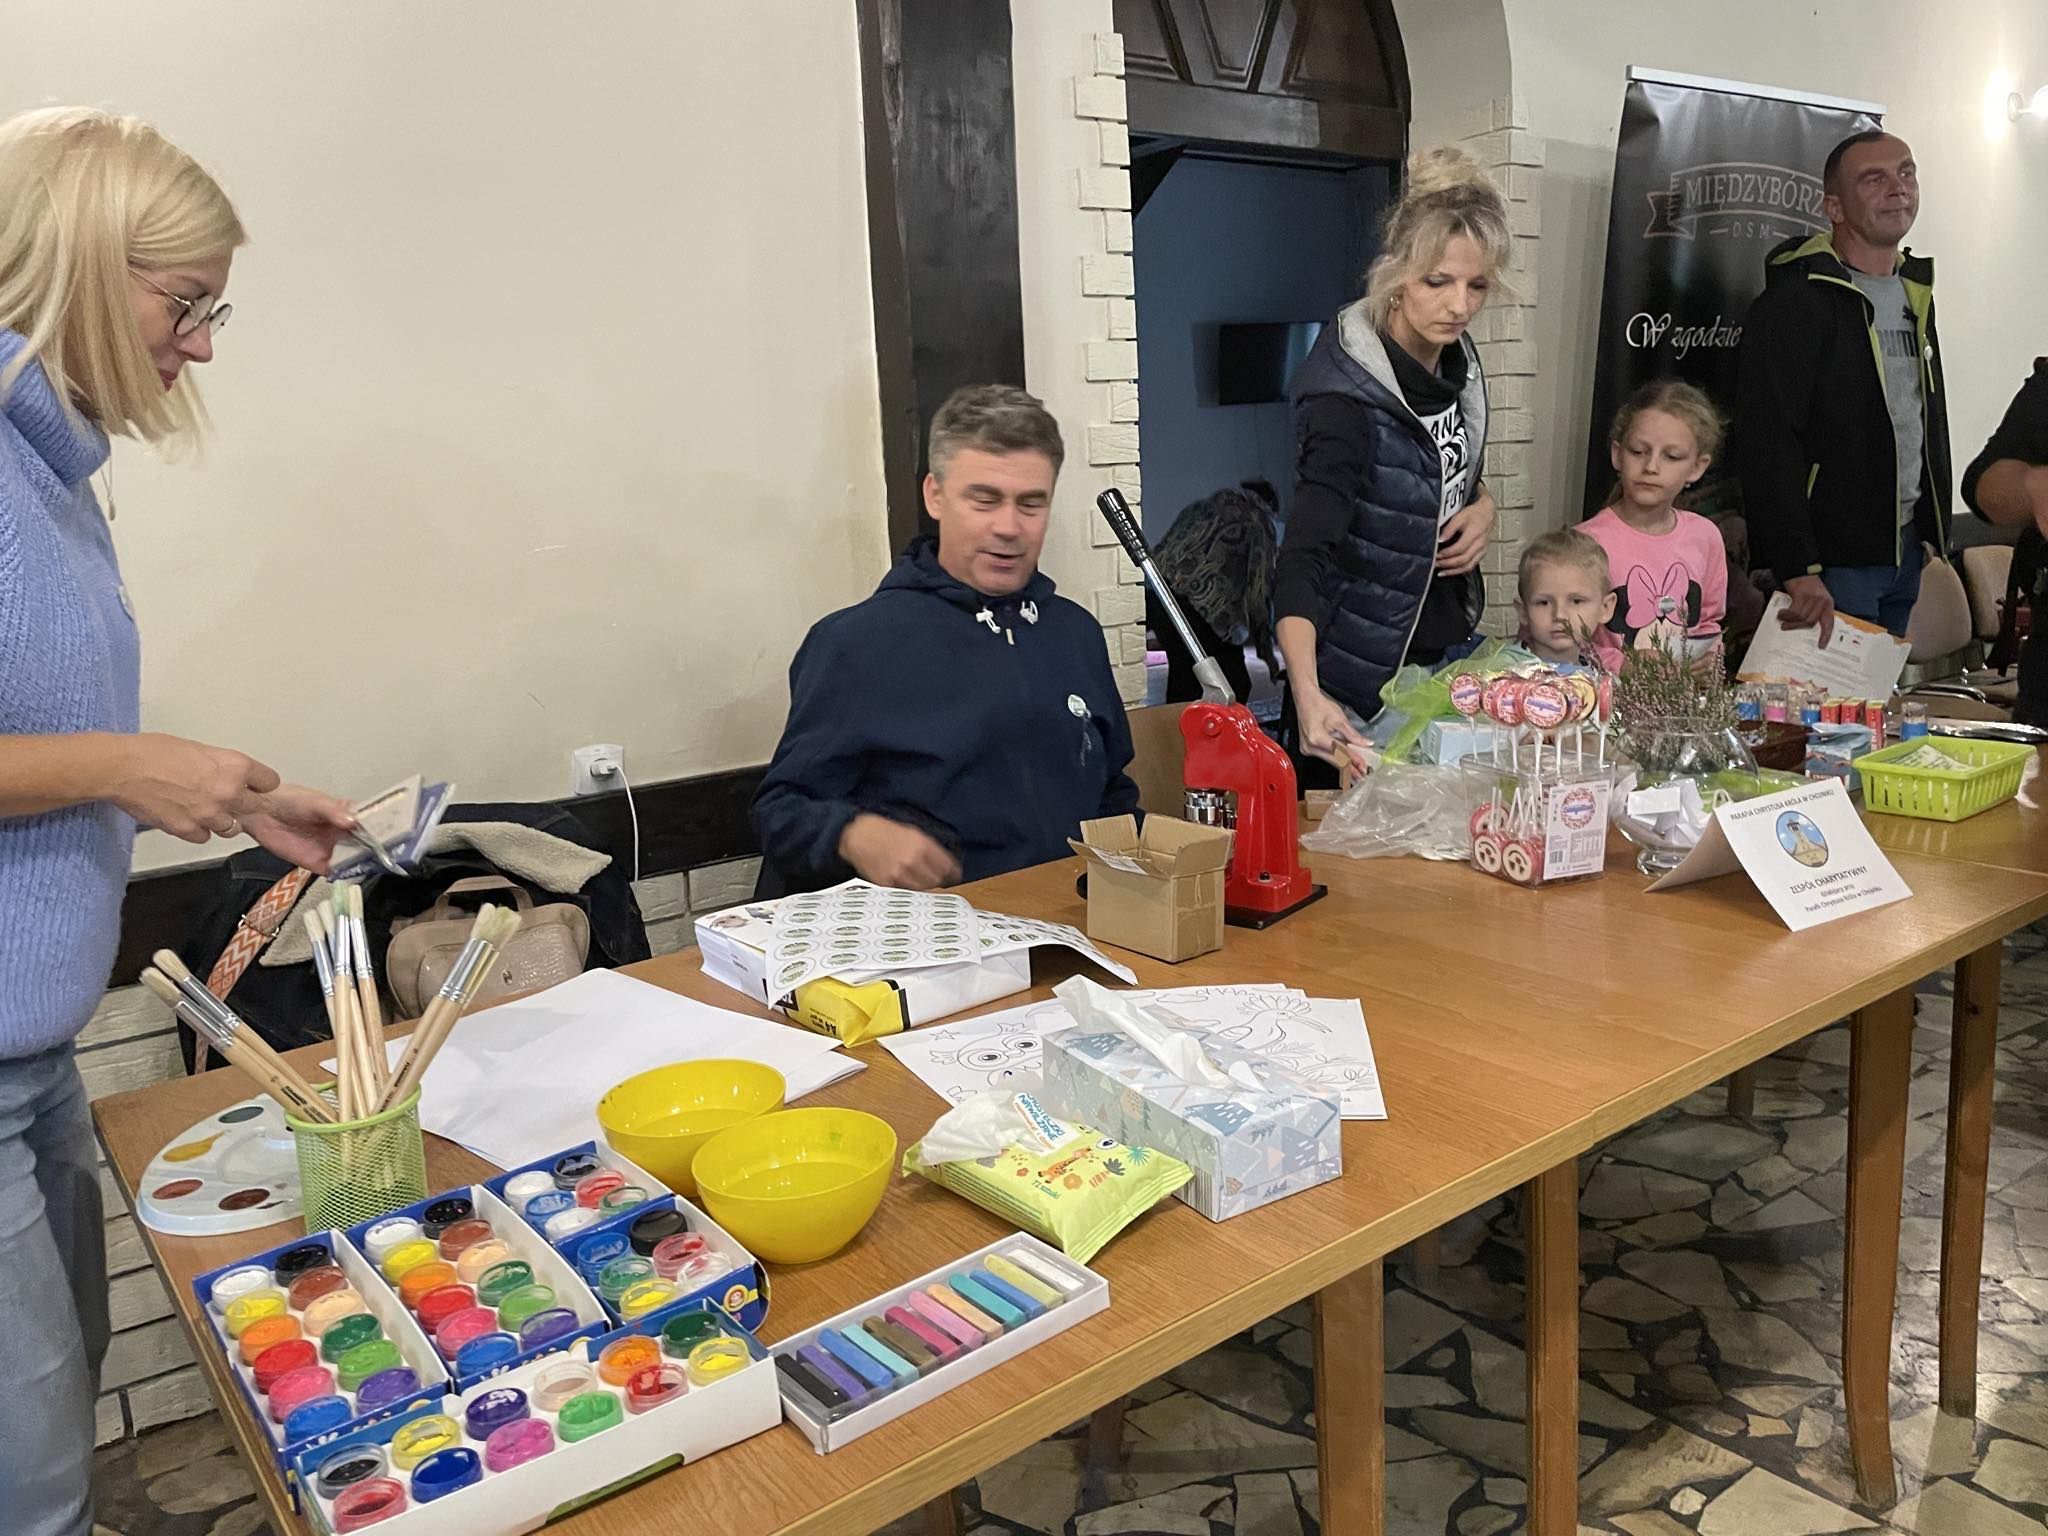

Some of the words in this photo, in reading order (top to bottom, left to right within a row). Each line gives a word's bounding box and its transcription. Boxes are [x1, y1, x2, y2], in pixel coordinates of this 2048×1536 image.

[1626, 312, 1671, 348] W
[1671, 314, 1742, 360] zgodzie
[1730, 809, 1754, 821] PARAFIA
[1754, 802, 1785, 815] CHRYSTUSA
[1814, 866, 1867, 887] CHARYTATYWNY
